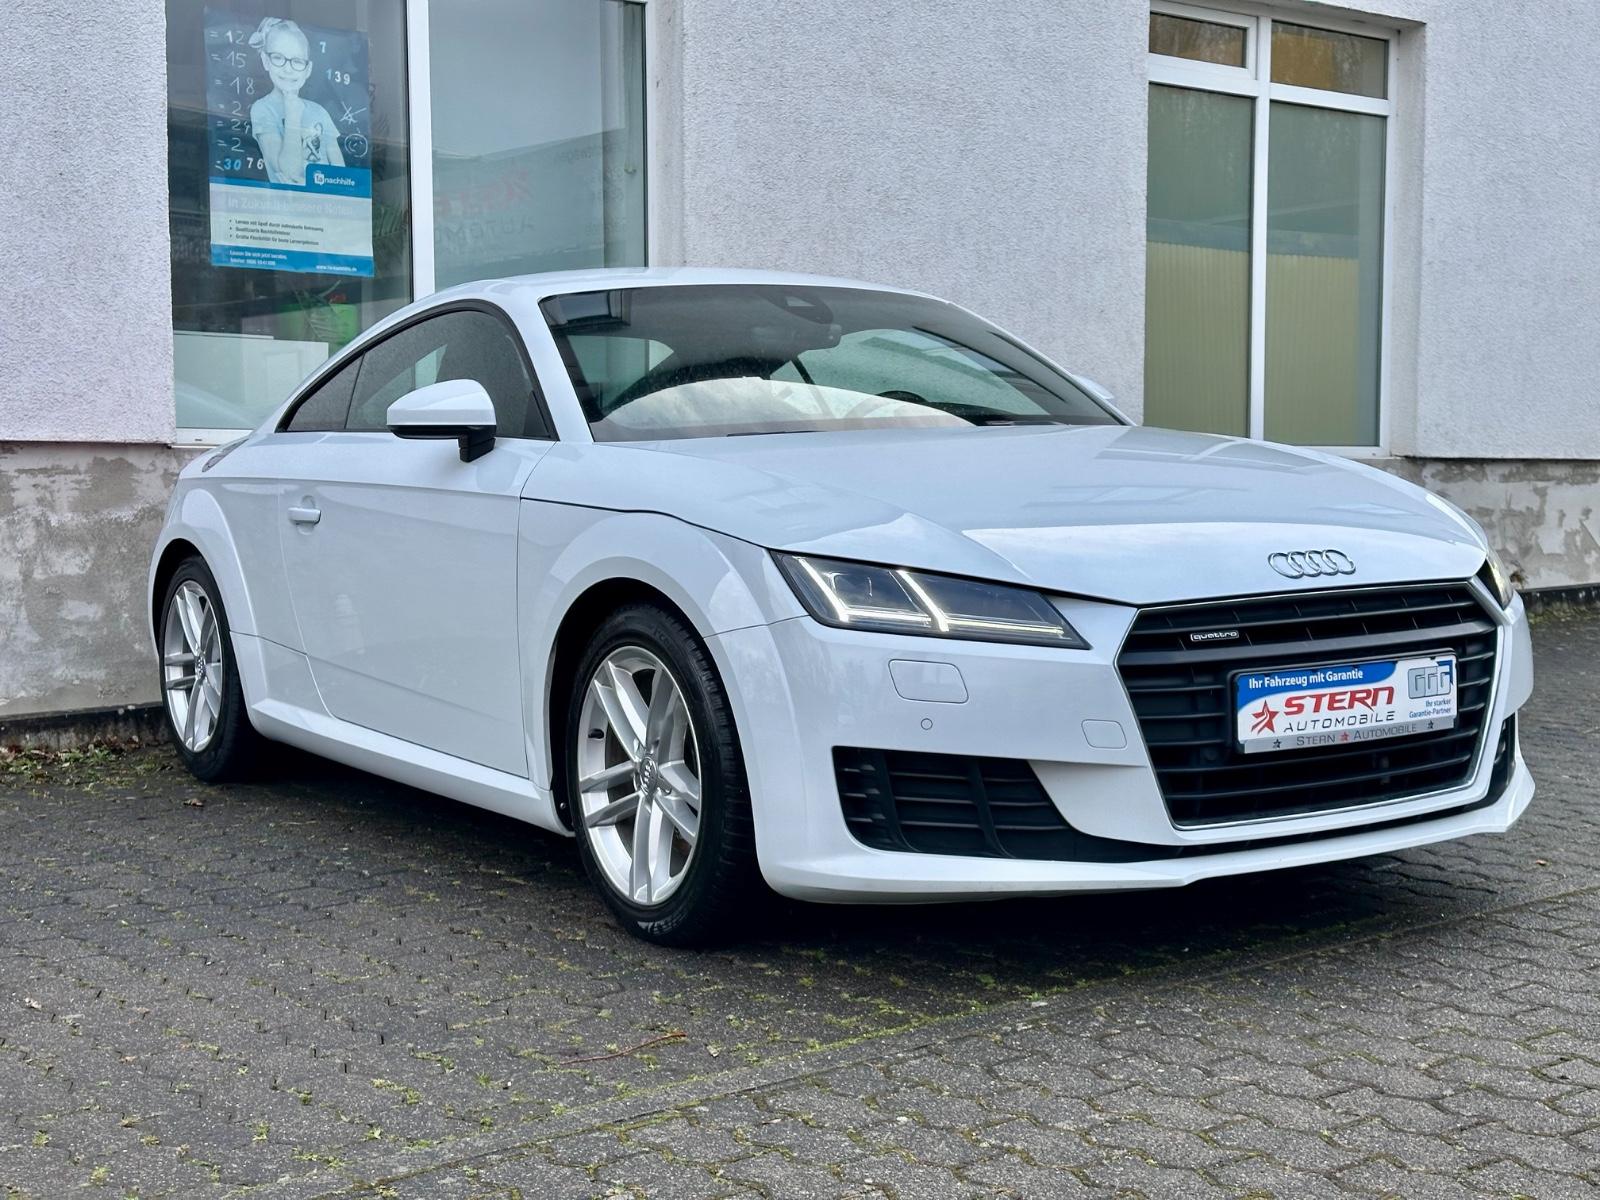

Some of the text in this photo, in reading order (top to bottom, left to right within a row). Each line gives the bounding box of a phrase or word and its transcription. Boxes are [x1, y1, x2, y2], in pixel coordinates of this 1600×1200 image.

[225, 30, 245, 45] 12
[320, 41, 326, 54] 7
[226, 51, 247, 68] 15
[230, 77, 256, 95] 18
[1193, 631, 1237, 641] quattro
[1249, 669, 1364, 689] Ihr Fahrzeug mit Garantie
[1283, 686, 1394, 717] STERN
[1284, 711, 1396, 733] AUTOMOBILE
[1296, 723, 1417, 747] STERN AUTOMOBILE
